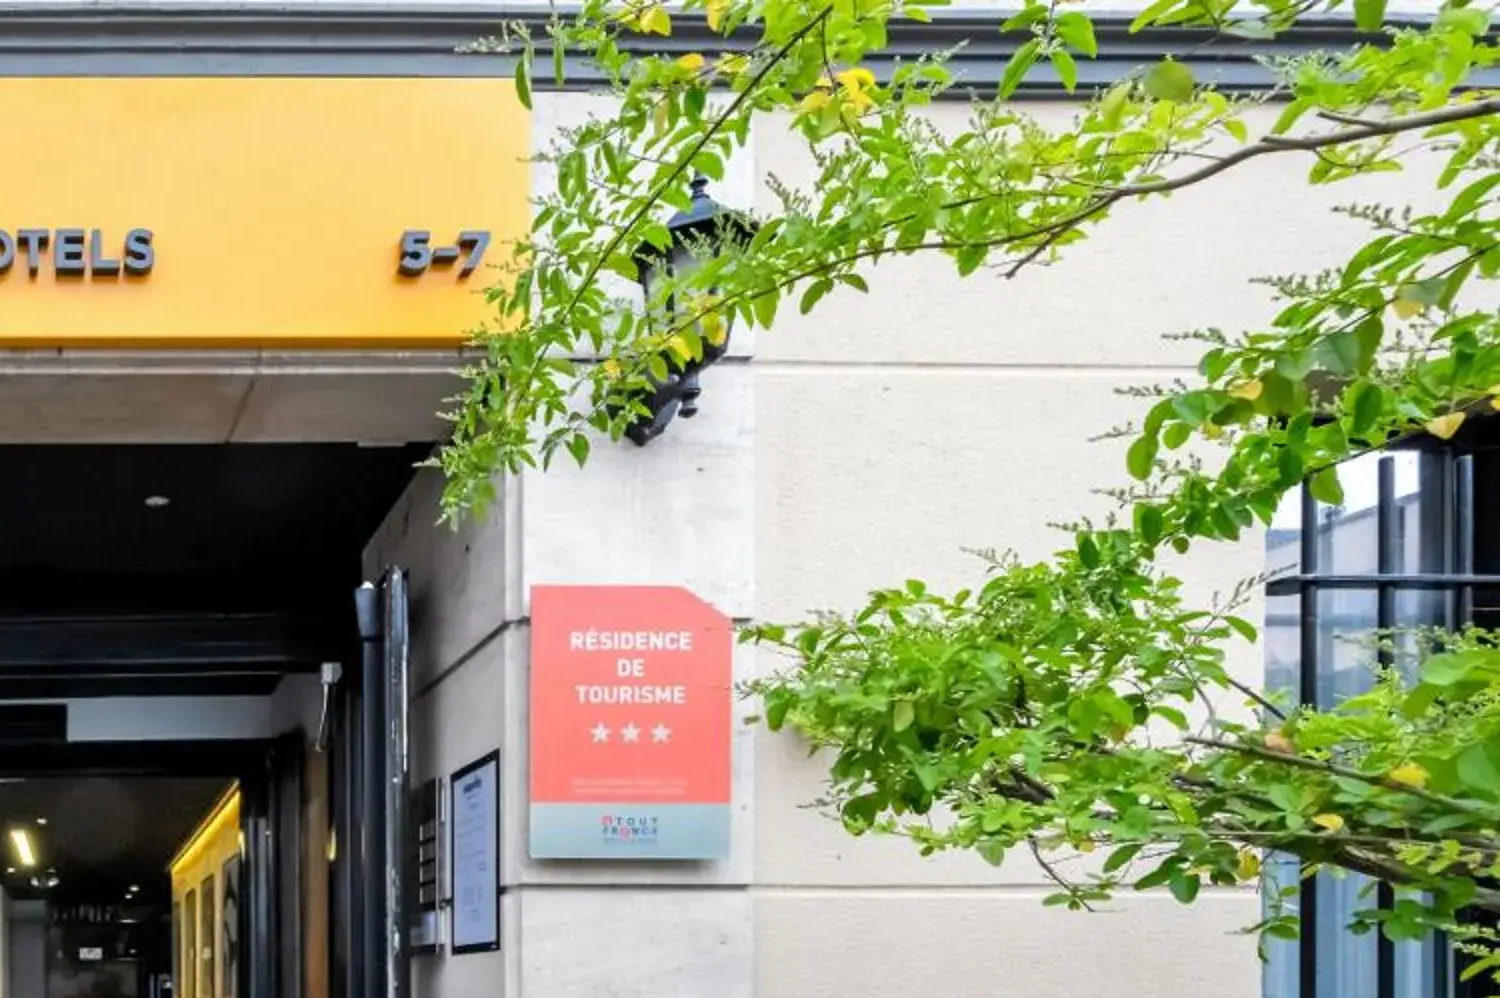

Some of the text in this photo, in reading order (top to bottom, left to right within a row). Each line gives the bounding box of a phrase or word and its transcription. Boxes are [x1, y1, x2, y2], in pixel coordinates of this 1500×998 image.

[397, 228, 490, 280] 5-7
[569, 625, 693, 651] RÉSIDENCE
[616, 658, 645, 678] DE
[573, 684, 687, 705] TOURISME
